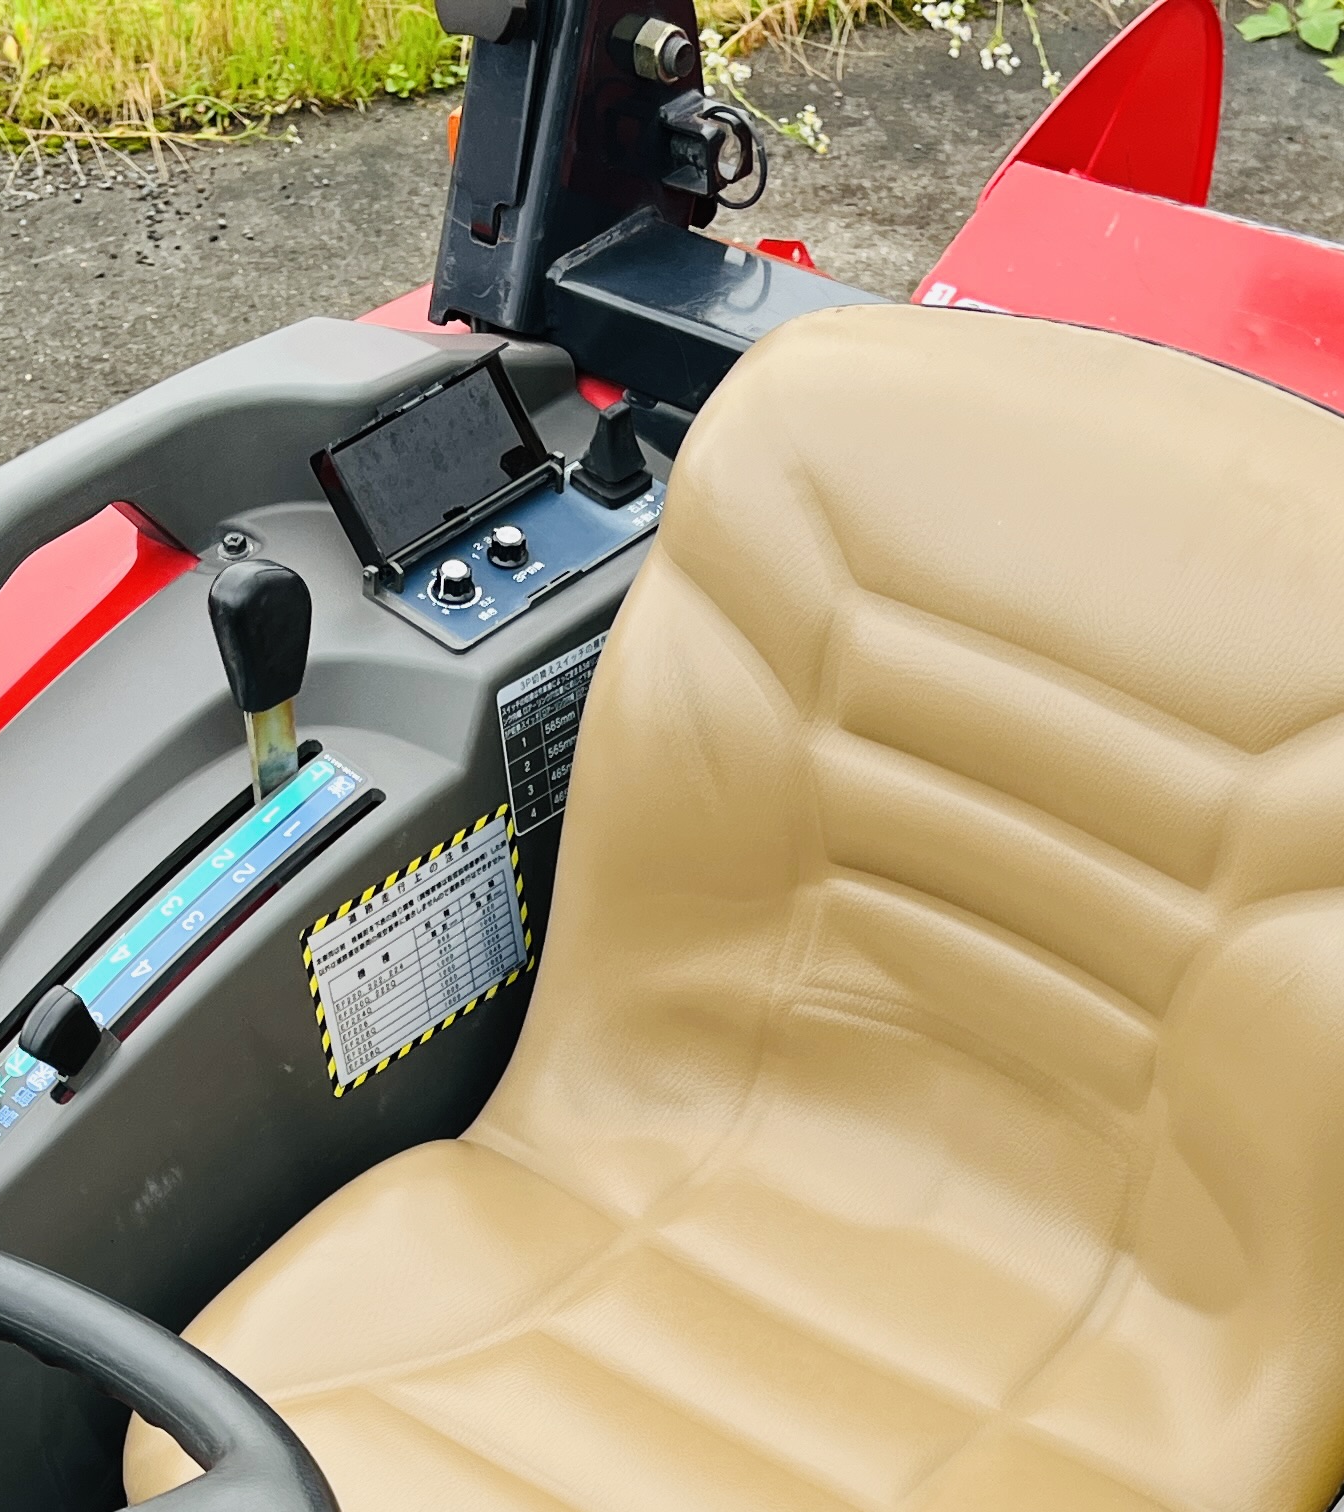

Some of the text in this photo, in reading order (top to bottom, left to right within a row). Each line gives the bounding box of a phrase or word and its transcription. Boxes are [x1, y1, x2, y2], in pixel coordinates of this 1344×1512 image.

[521, 735, 527, 749] 1
[309, 760, 335, 782] 上
[523, 759, 531, 773] 2
[526, 782, 535, 797] 3
[262, 806, 282, 824] 1
[529, 805, 537, 820] 4
[282, 821, 302, 838] 1
[211, 849, 235, 869] 2
[232, 862, 256, 885] 2
[160, 895, 184, 917] 3
[182, 910, 205, 931] 3
[109, 943, 132, 964] 4
[131, 958, 153, 979] 4
